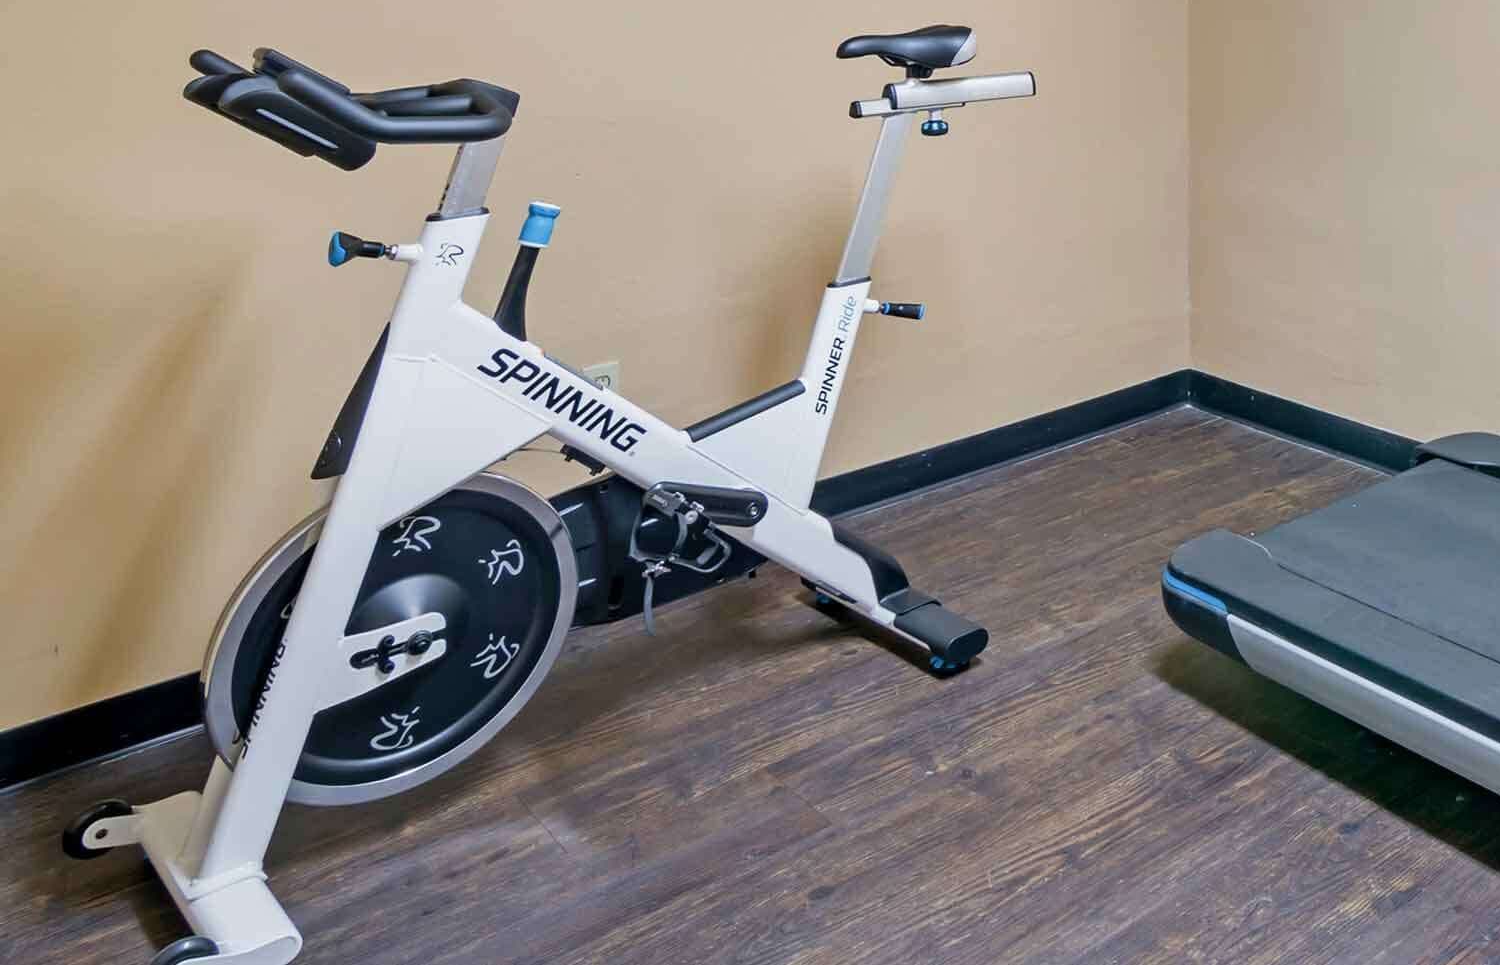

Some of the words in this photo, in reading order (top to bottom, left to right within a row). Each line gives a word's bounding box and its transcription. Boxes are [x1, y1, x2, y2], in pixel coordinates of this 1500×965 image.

[477, 348, 648, 453] SPINNING
[815, 337, 846, 415] SPINNER
[837, 295, 857, 333] Ride
